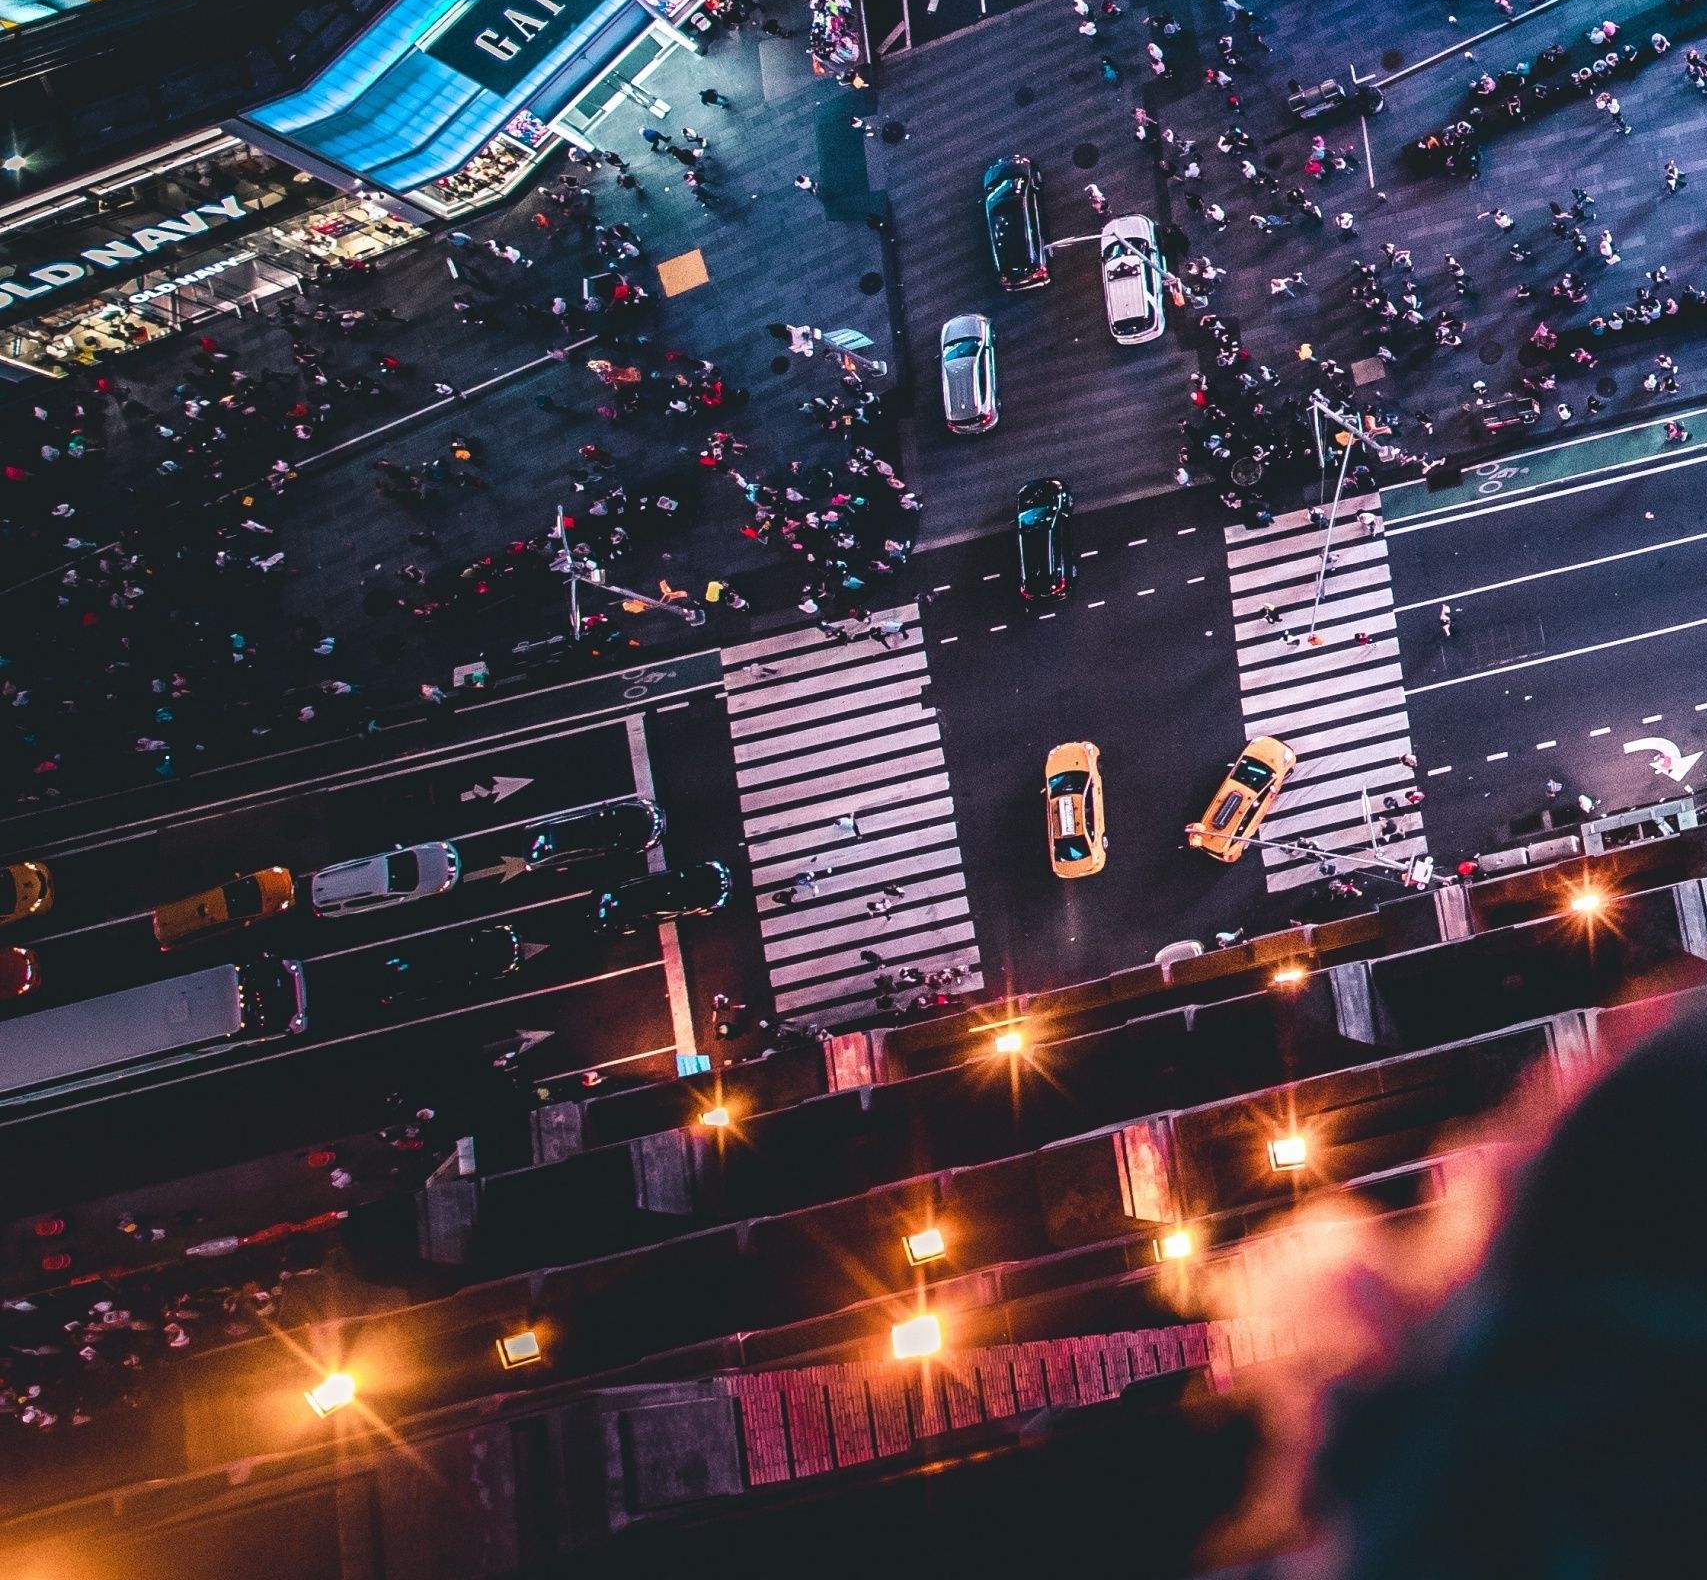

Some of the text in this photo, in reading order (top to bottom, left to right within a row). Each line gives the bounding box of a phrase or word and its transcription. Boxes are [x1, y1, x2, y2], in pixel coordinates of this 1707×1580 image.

[82, 194, 248, 270] NAVY
[128, 256, 239, 304] OLD NAVY
